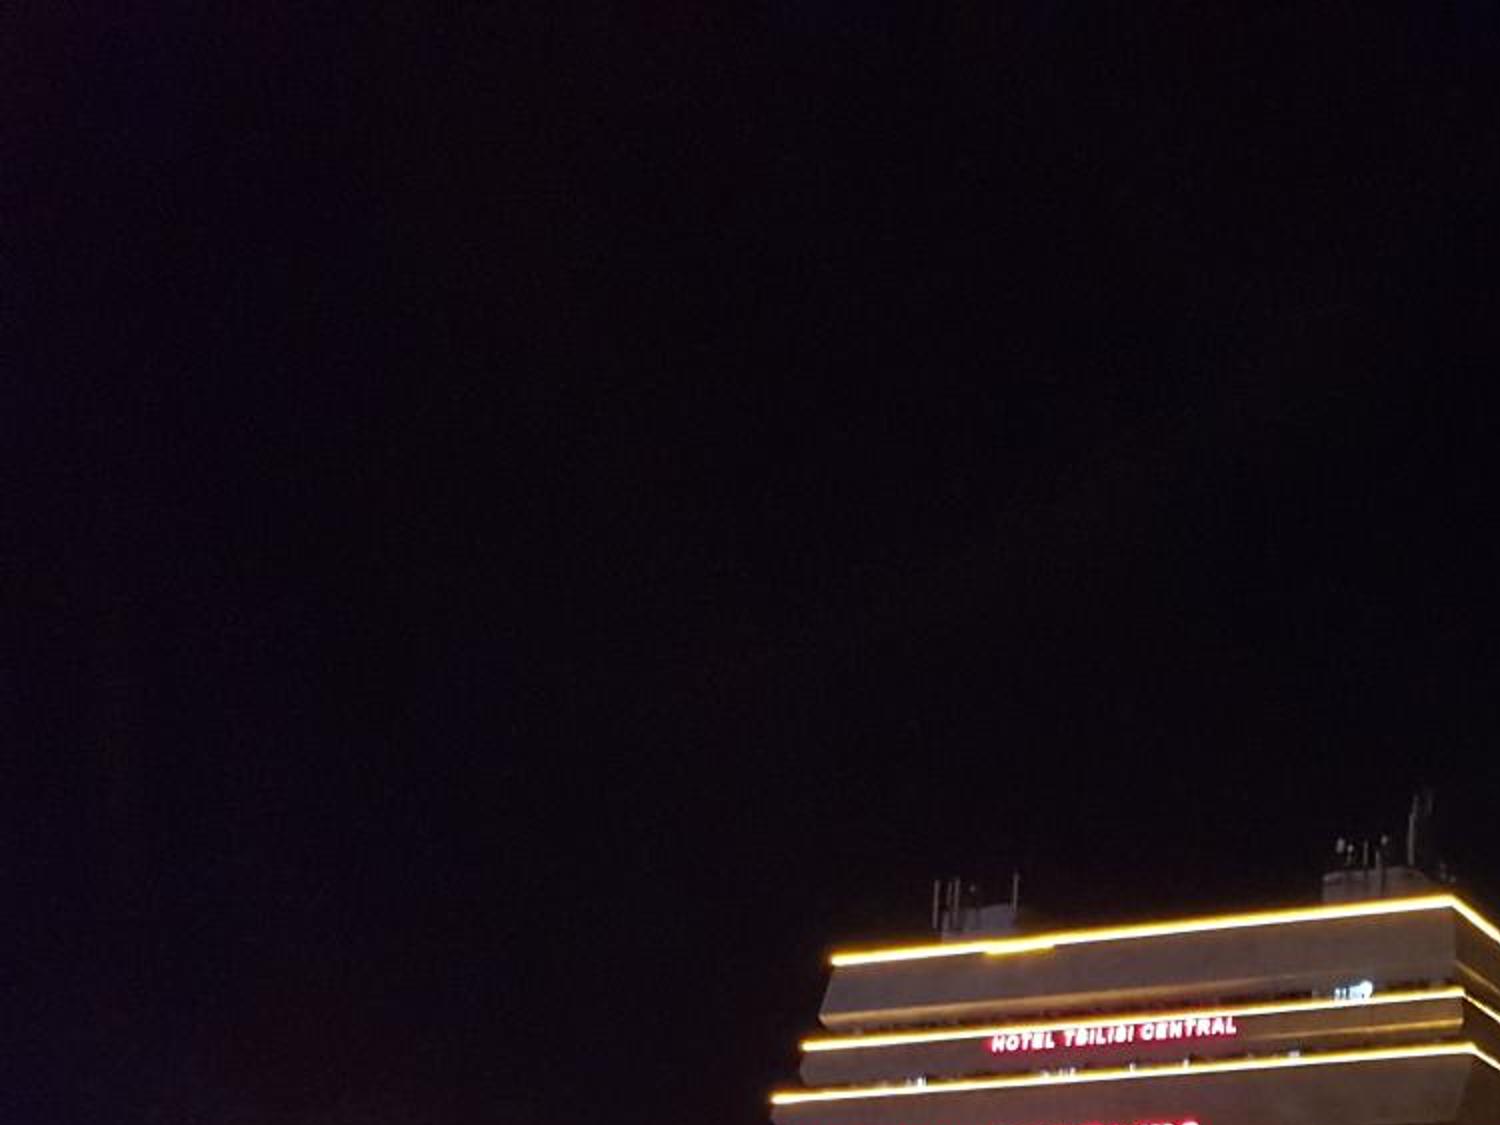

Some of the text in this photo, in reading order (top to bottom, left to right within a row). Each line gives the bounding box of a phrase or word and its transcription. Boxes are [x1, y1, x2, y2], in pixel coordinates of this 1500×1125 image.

[991, 1017, 1237, 1052] HOTEL TBILISI CENTRAL
